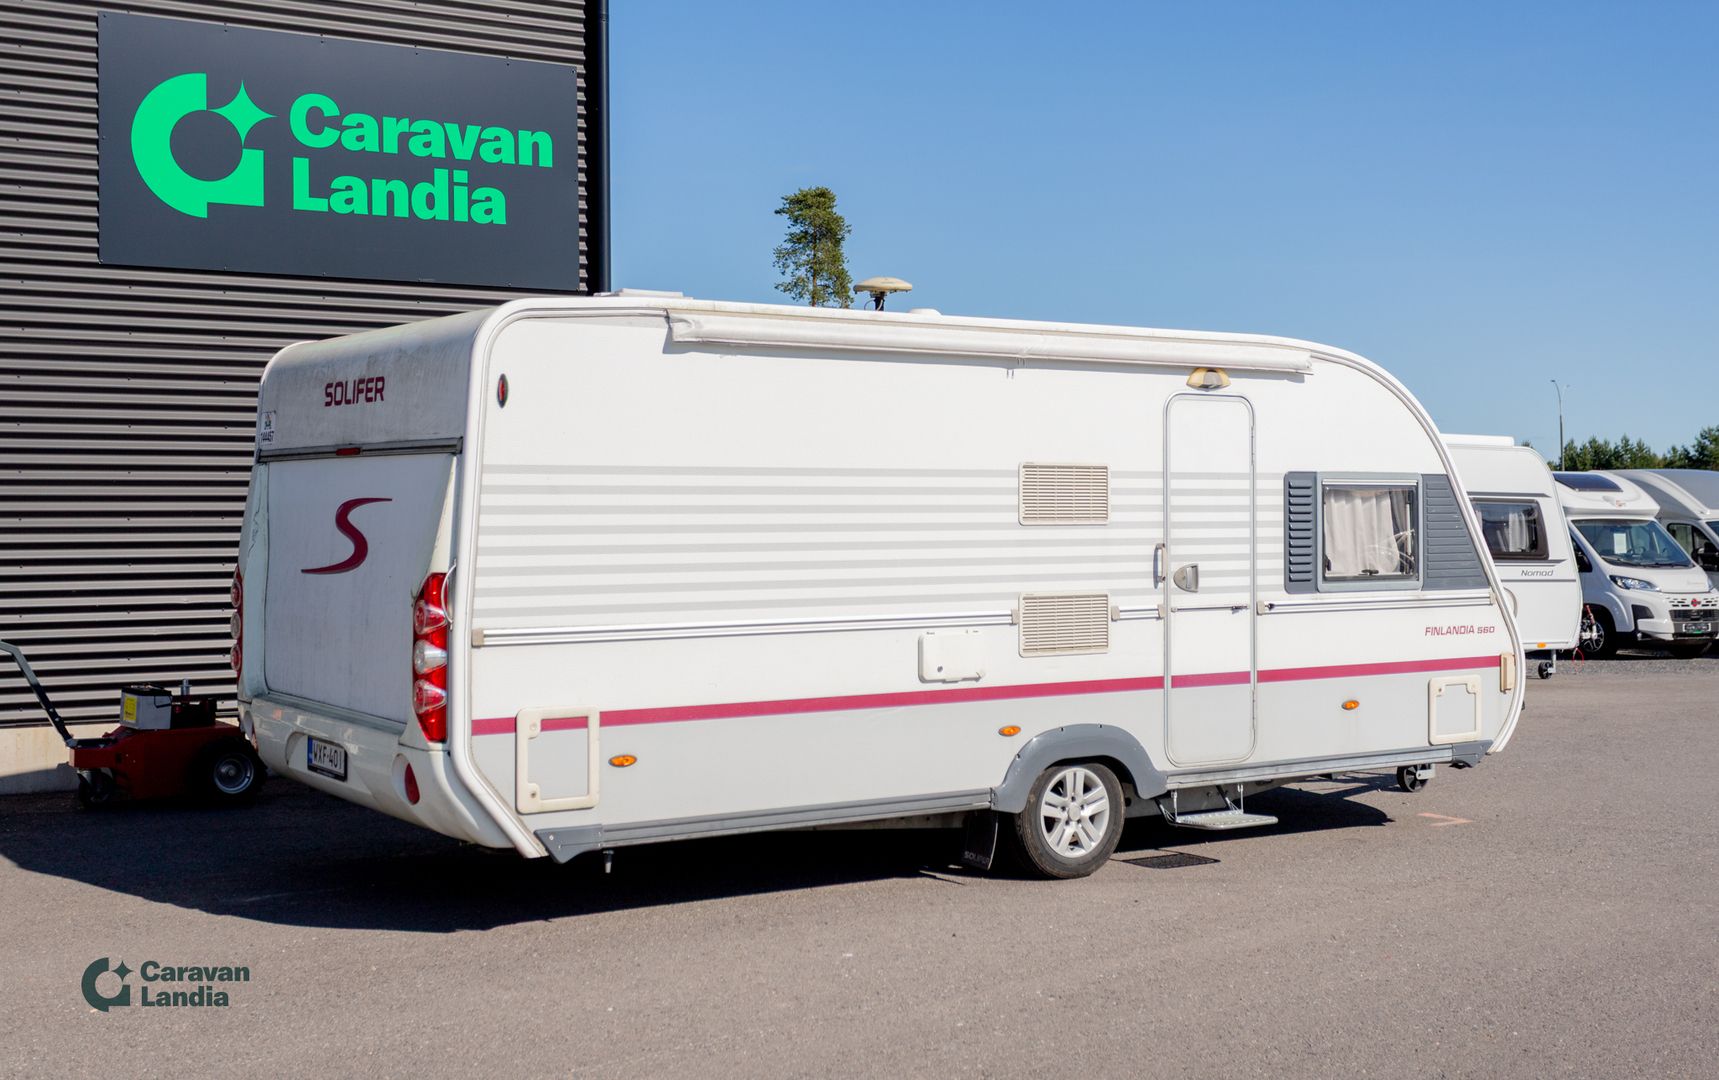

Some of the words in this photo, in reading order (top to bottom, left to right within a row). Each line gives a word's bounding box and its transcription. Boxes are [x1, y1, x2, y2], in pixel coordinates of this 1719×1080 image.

[289, 93, 553, 168] Caravan
[292, 157, 507, 225] Landia
[324, 376, 386, 407] SOLIFER
[301, 497, 393, 575] S
[1520, 569, 1554, 577] Nomad
[1424, 625, 1475, 636] FINLANDIA
[1477, 626, 1495, 634] 560
